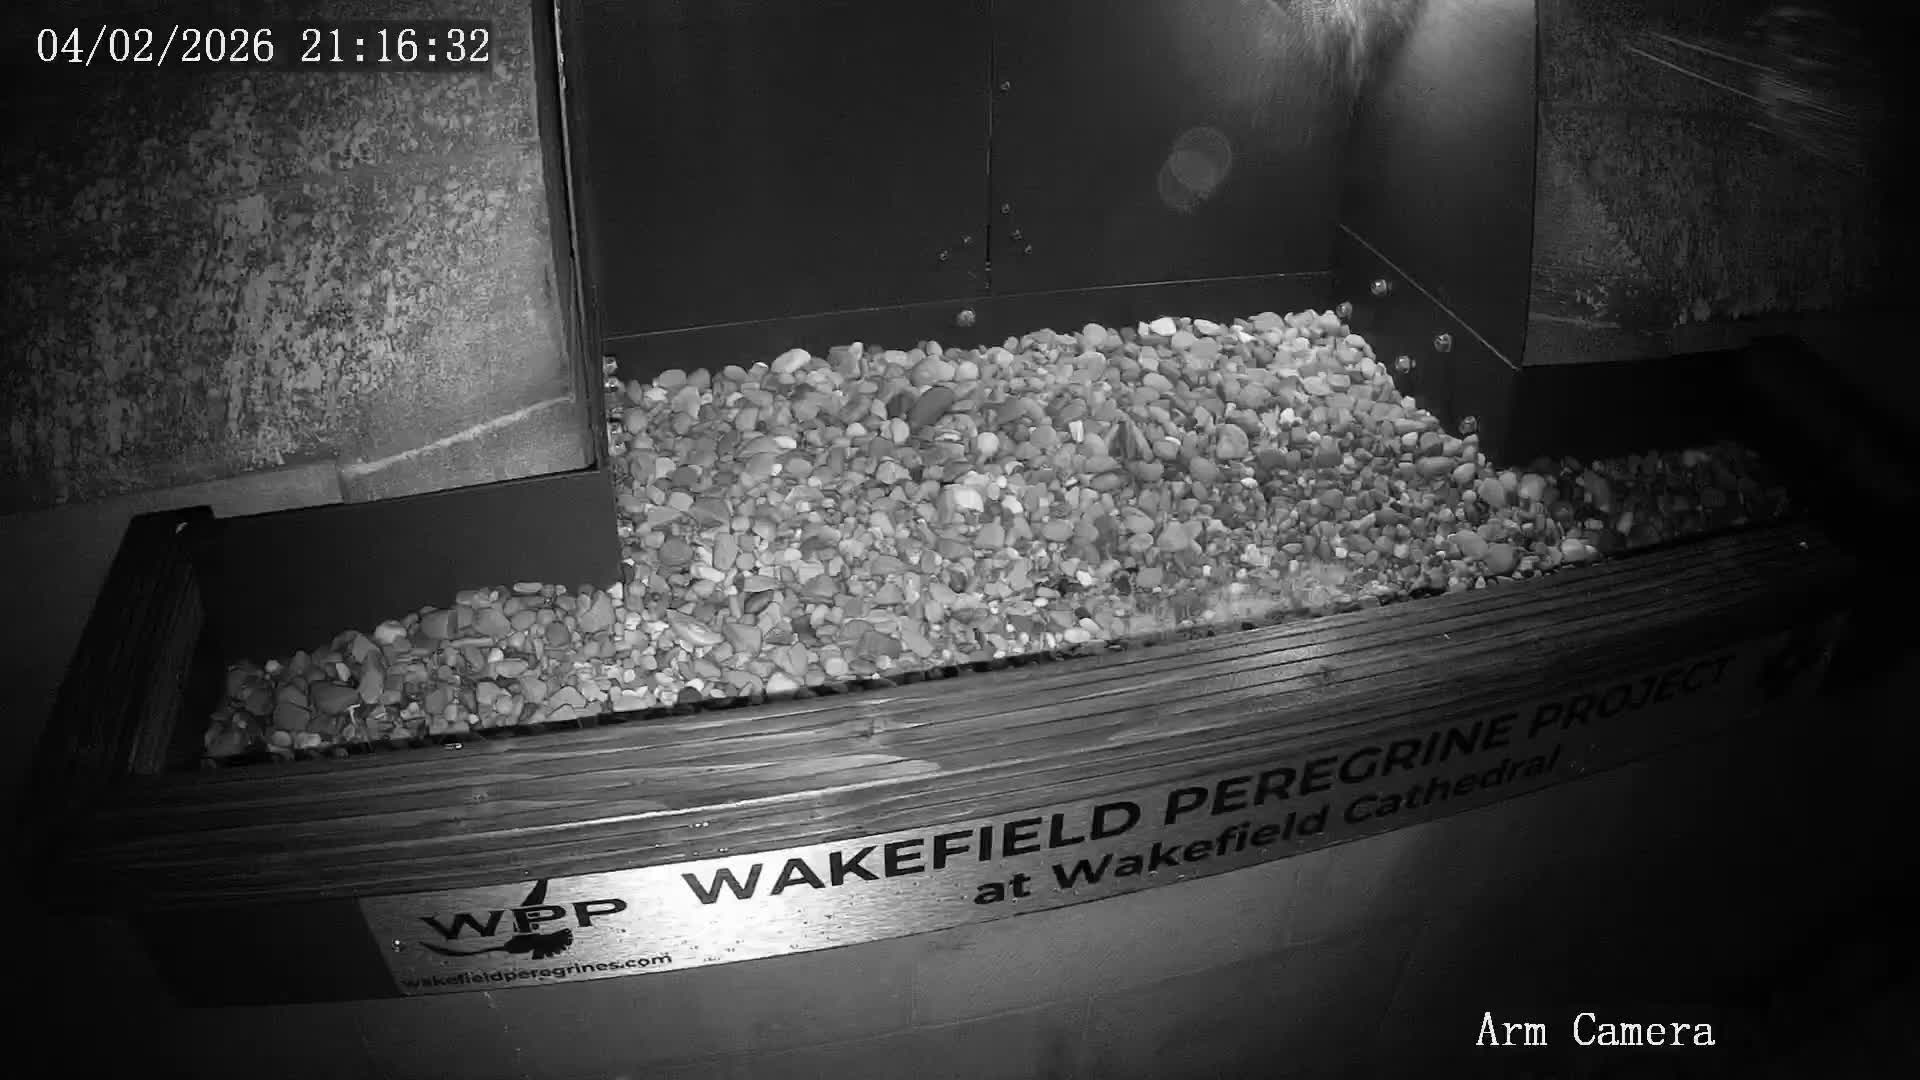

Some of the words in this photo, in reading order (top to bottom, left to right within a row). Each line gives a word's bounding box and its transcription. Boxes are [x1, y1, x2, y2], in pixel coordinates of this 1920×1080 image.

[682, 800, 1141, 905] WAKEFIELD
[1163, 712, 1517, 826] PEREGRINE
[1528, 655, 1737, 740] PROJECT
[973, 872, 1031, 905] at
[1052, 806, 1327, 890] Wakefield
[1343, 744, 1561, 825] Cathedral
[418, 898, 628, 940] WPP
[401, 952, 673, 989] wakefieldperegrines.com
